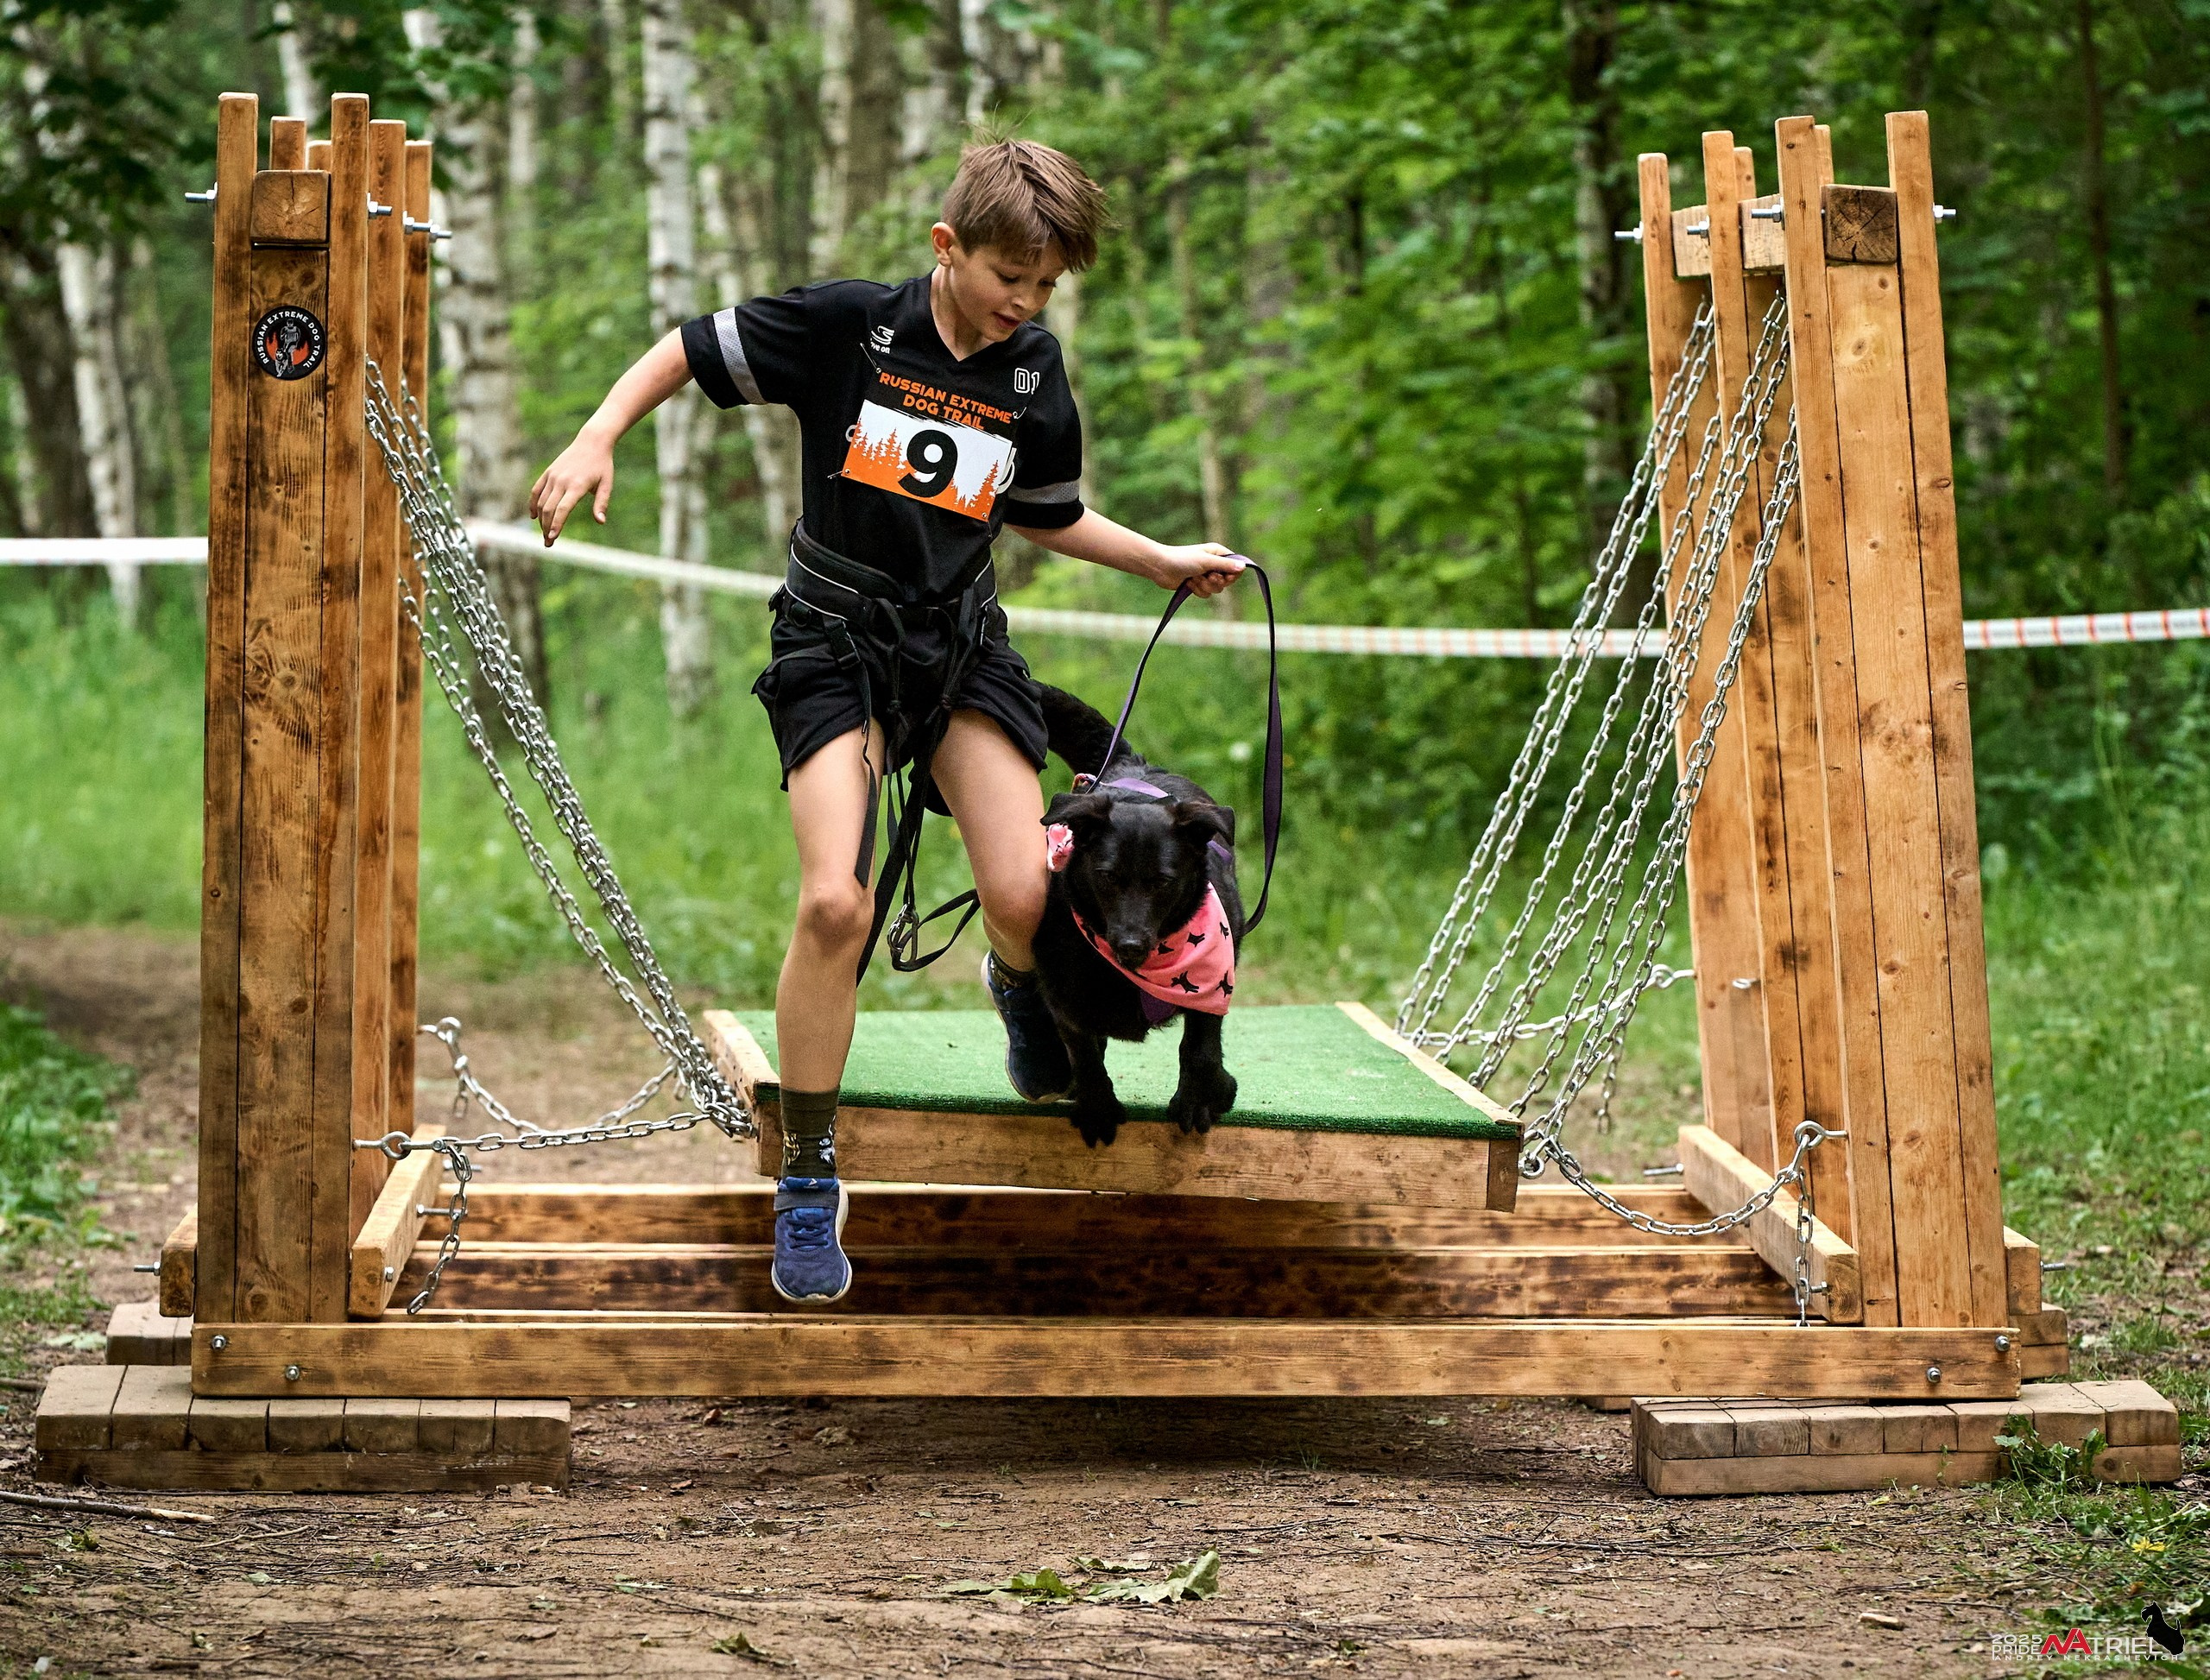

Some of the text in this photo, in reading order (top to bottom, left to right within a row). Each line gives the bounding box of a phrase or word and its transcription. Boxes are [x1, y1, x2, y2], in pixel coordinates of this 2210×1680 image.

[256, 311, 320, 369] RUSSIAN EXTREME DOG TRAIL
[879, 371, 1013, 424] RUSSIAN EXTREME
[902, 395, 985, 429] DOG TRAIL
[898, 429, 958, 498] 9
